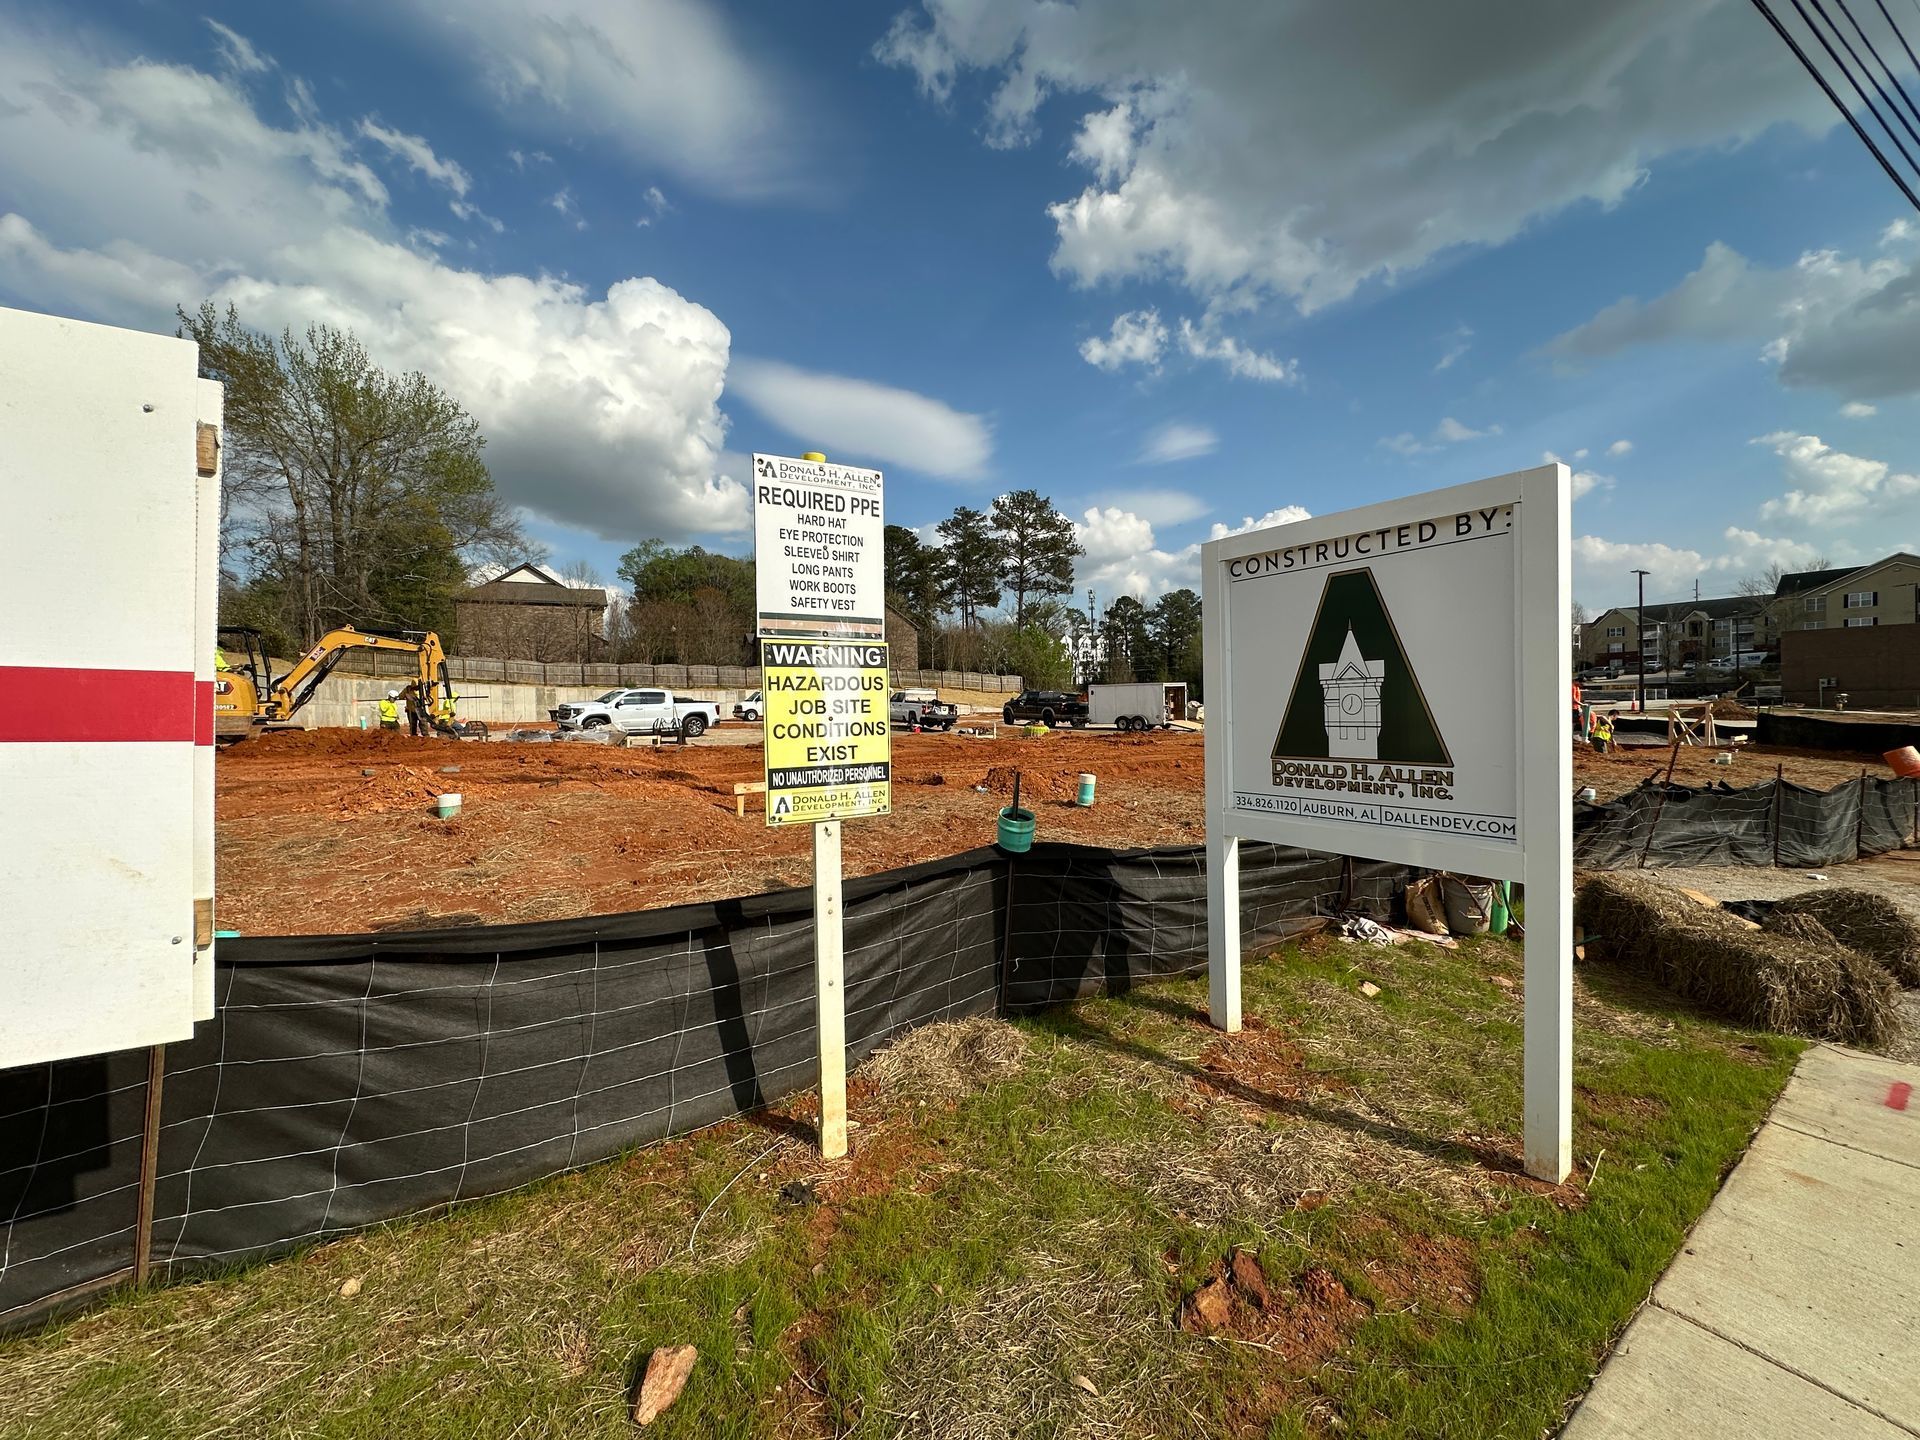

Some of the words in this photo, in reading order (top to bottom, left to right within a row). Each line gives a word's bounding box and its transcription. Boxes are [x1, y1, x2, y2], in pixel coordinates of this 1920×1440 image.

[780, 463, 826, 476] DONALD
[829, 470, 840, 479] H.
[844, 472, 877, 484] ALLEN
[759, 485, 846, 512] REQUIRED
[850, 496, 880, 518] PPE
[797, 514, 826, 527] HARD
[828, 517, 847, 530] HAT
[780, 528, 800, 541] EYE
[802, 530, 864, 548] PROTECTION
[1230, 521, 1437, 578] CONSTRUCTED
[1455, 508, 1512, 536] BY:
[784, 546, 830, 560] SLEEVED
[832, 550, 860, 563] SHIRT
[792, 562, 820, 576] LONG
[822, 566, 854, 578] PANTS
[789, 579, 821, 592] WORK
[824, 582, 856, 595] BOOTS
[791, 596, 829, 610] SAFETY
[831, 599, 856, 611] VEST
[772, 644, 881, 666] WARNING
[768, 676, 884, 692] HAZARDOUS
[789, 700, 826, 715] JOB
[832, 699, 871, 714] SITE
[773, 721, 886, 740] CONDITIONS
[806, 745, 858, 762] EXIST
[772, 772, 785, 787] NO
[786, 768, 844, 786] UNAUTHORIZED
[844, 766, 886, 782] PERSONNEL
[1271, 759, 1348, 780] DONALD
[1350, 764, 1374, 782] H.
[1378, 766, 1454, 786] ALLEN
[1272, 774, 1404, 798] DEVELOPMENT,
[1411, 782, 1454, 801] INC.
[792, 794, 838, 805] DONALD
[840, 791, 852, 801] H.
[854, 790, 886, 800] ALLEN
[792, 800, 865, 812] DEVELOPMENT,
[1236, 796, 1298, 812] 334.826.1120
[1303, 804, 1358, 820] AUBURN,
[1360, 809, 1378, 820] AL
[1384, 810, 1516, 836] DALLENDEV.COM
